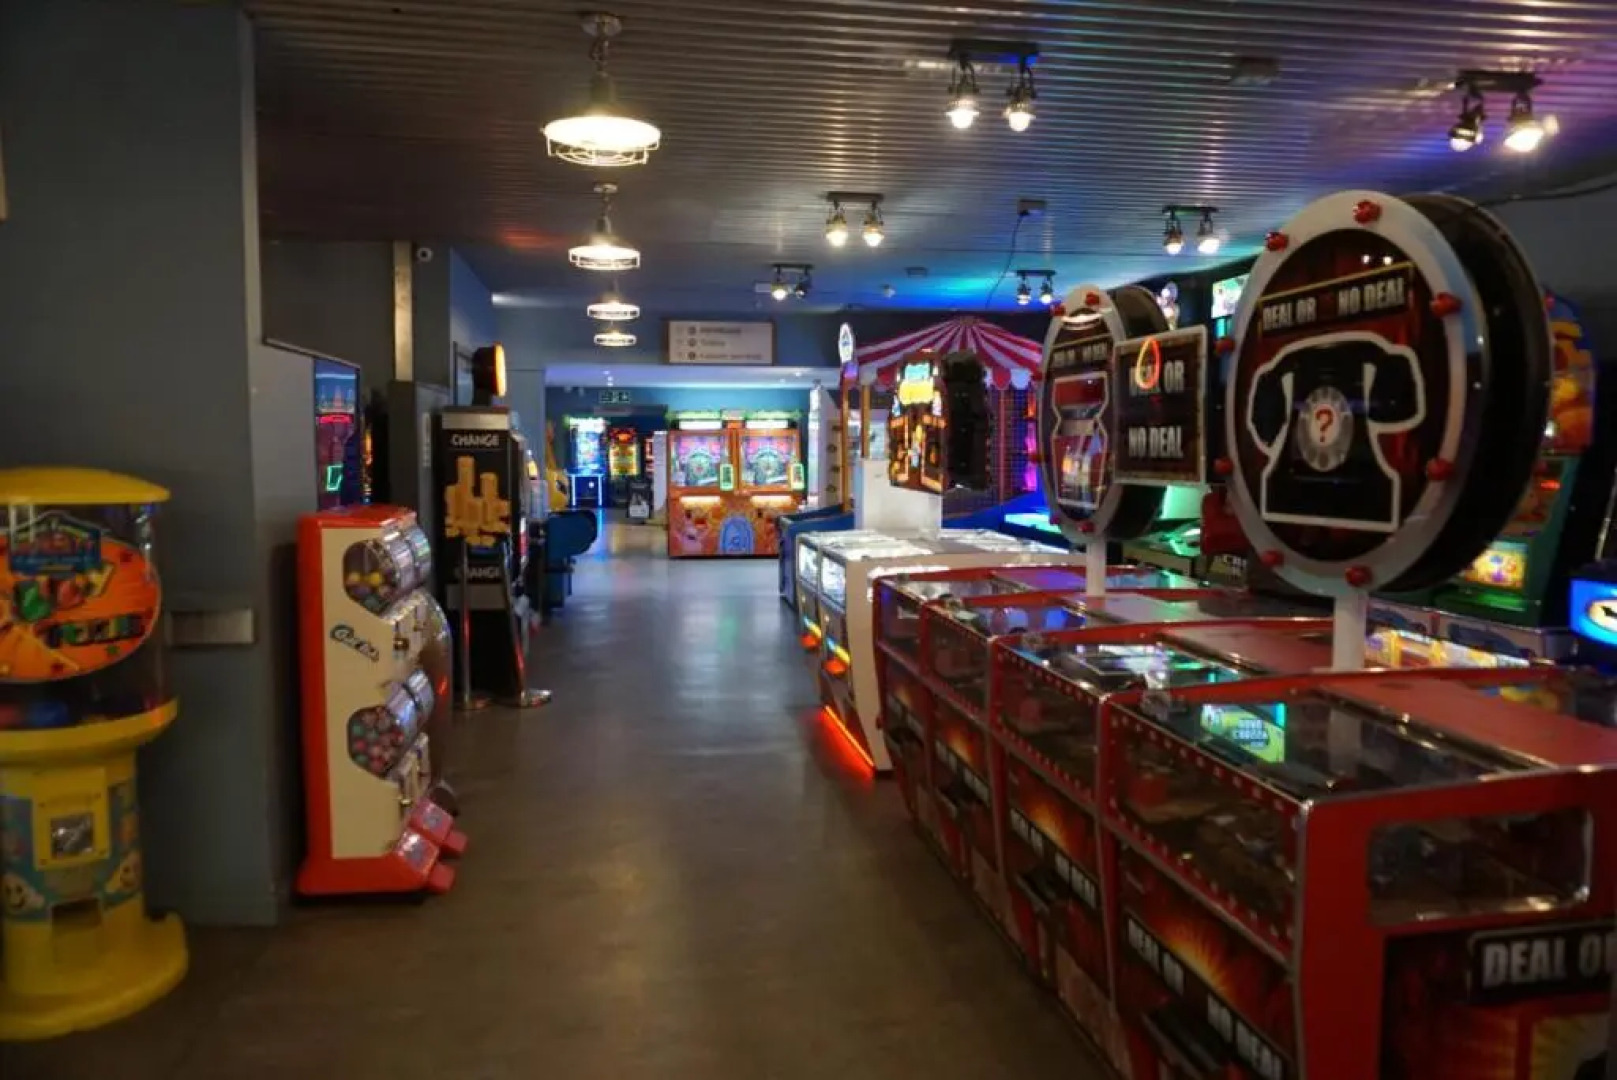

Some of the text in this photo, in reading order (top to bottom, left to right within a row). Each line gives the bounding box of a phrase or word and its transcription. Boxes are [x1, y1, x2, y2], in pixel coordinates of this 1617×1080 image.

[1263, 277, 1405, 331] DEAL OR NO DEAL
[1164, 360, 1185, 394] OR
[451, 432, 500, 447] CHANGE
[1128, 426, 1183, 458] NO DEAL
[1482, 936, 1567, 988] DEAL
